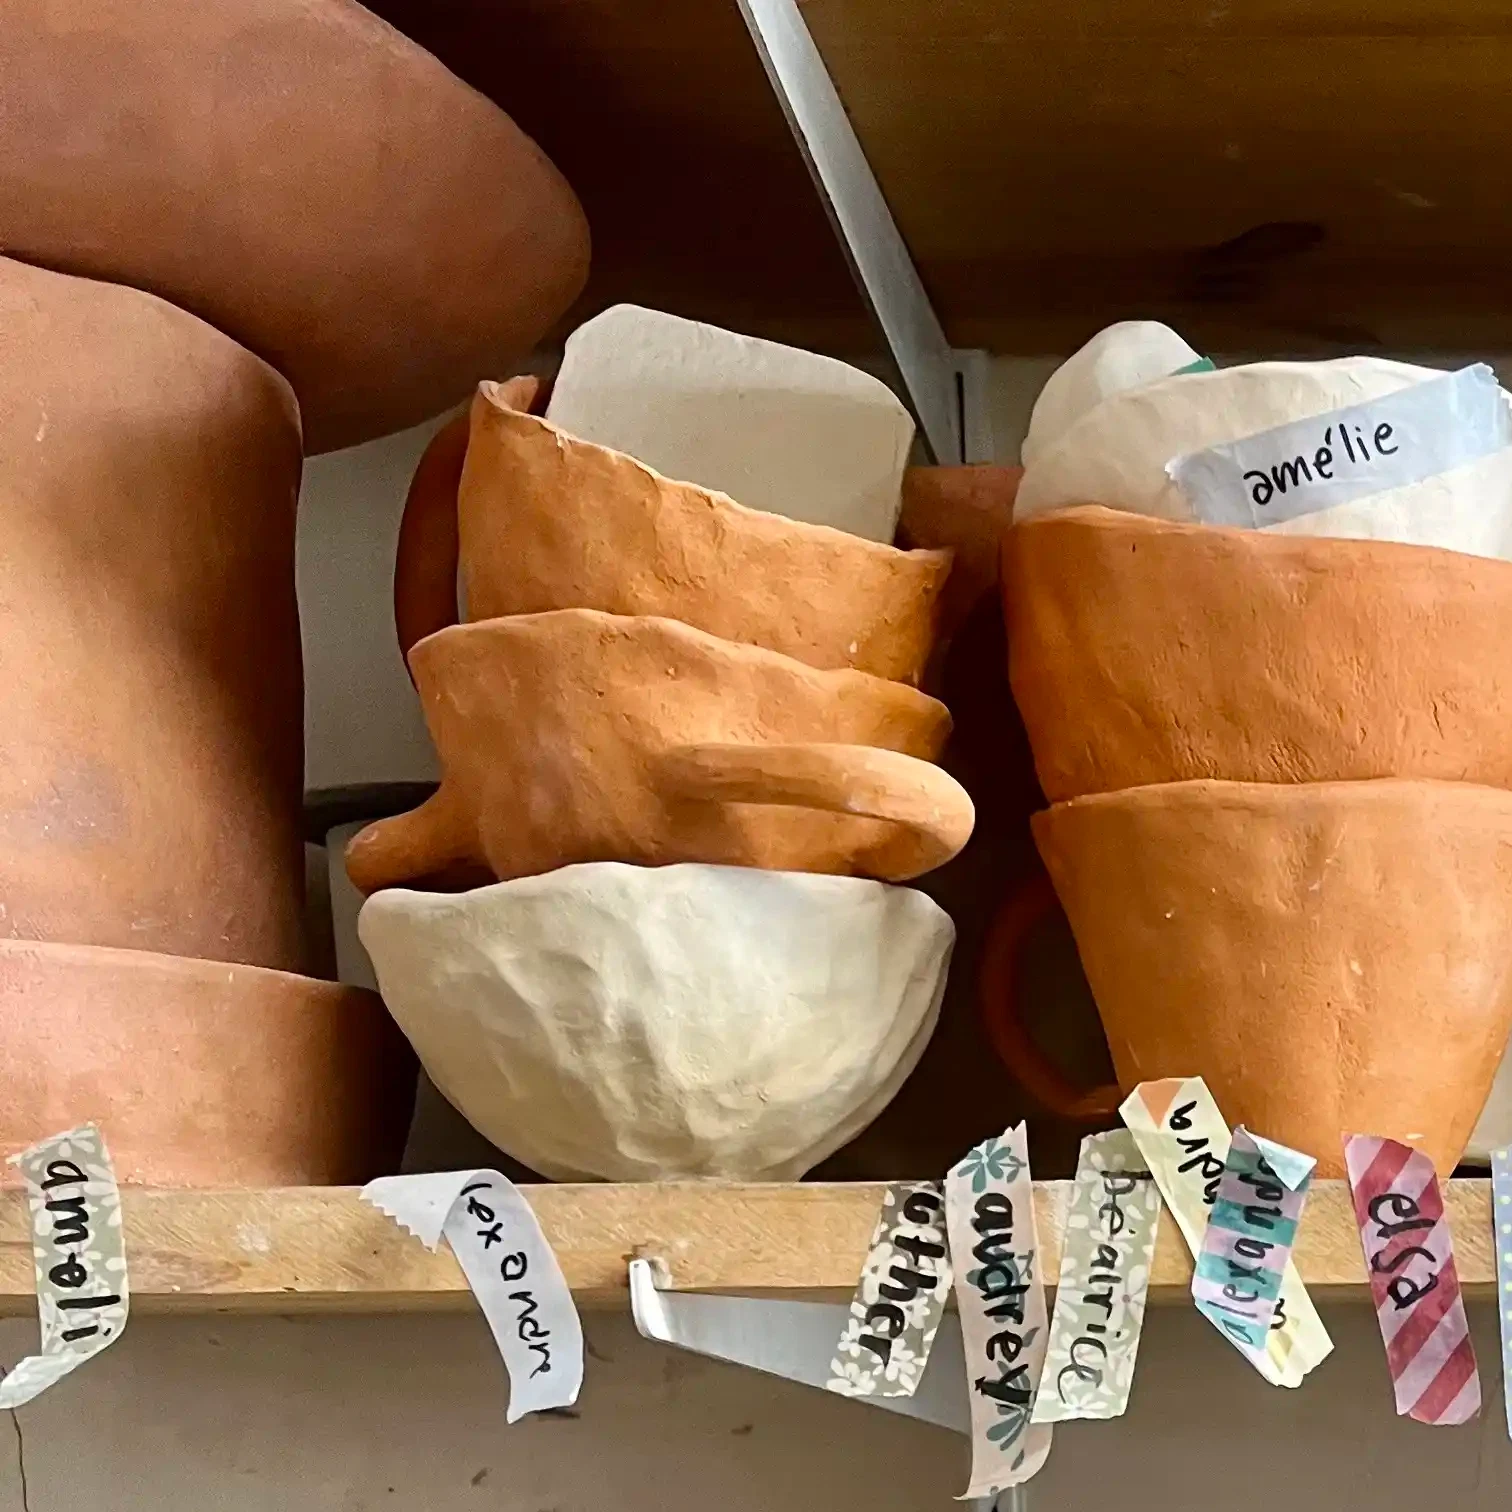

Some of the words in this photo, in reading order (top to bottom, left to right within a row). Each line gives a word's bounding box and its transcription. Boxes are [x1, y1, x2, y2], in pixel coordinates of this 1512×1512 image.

[1243, 418, 1400, 506] amélie
[970, 1192, 1034, 1400] audrey
[1056, 1170, 1153, 1406] béatrice
[1368, 1192, 1440, 1312] elsa
